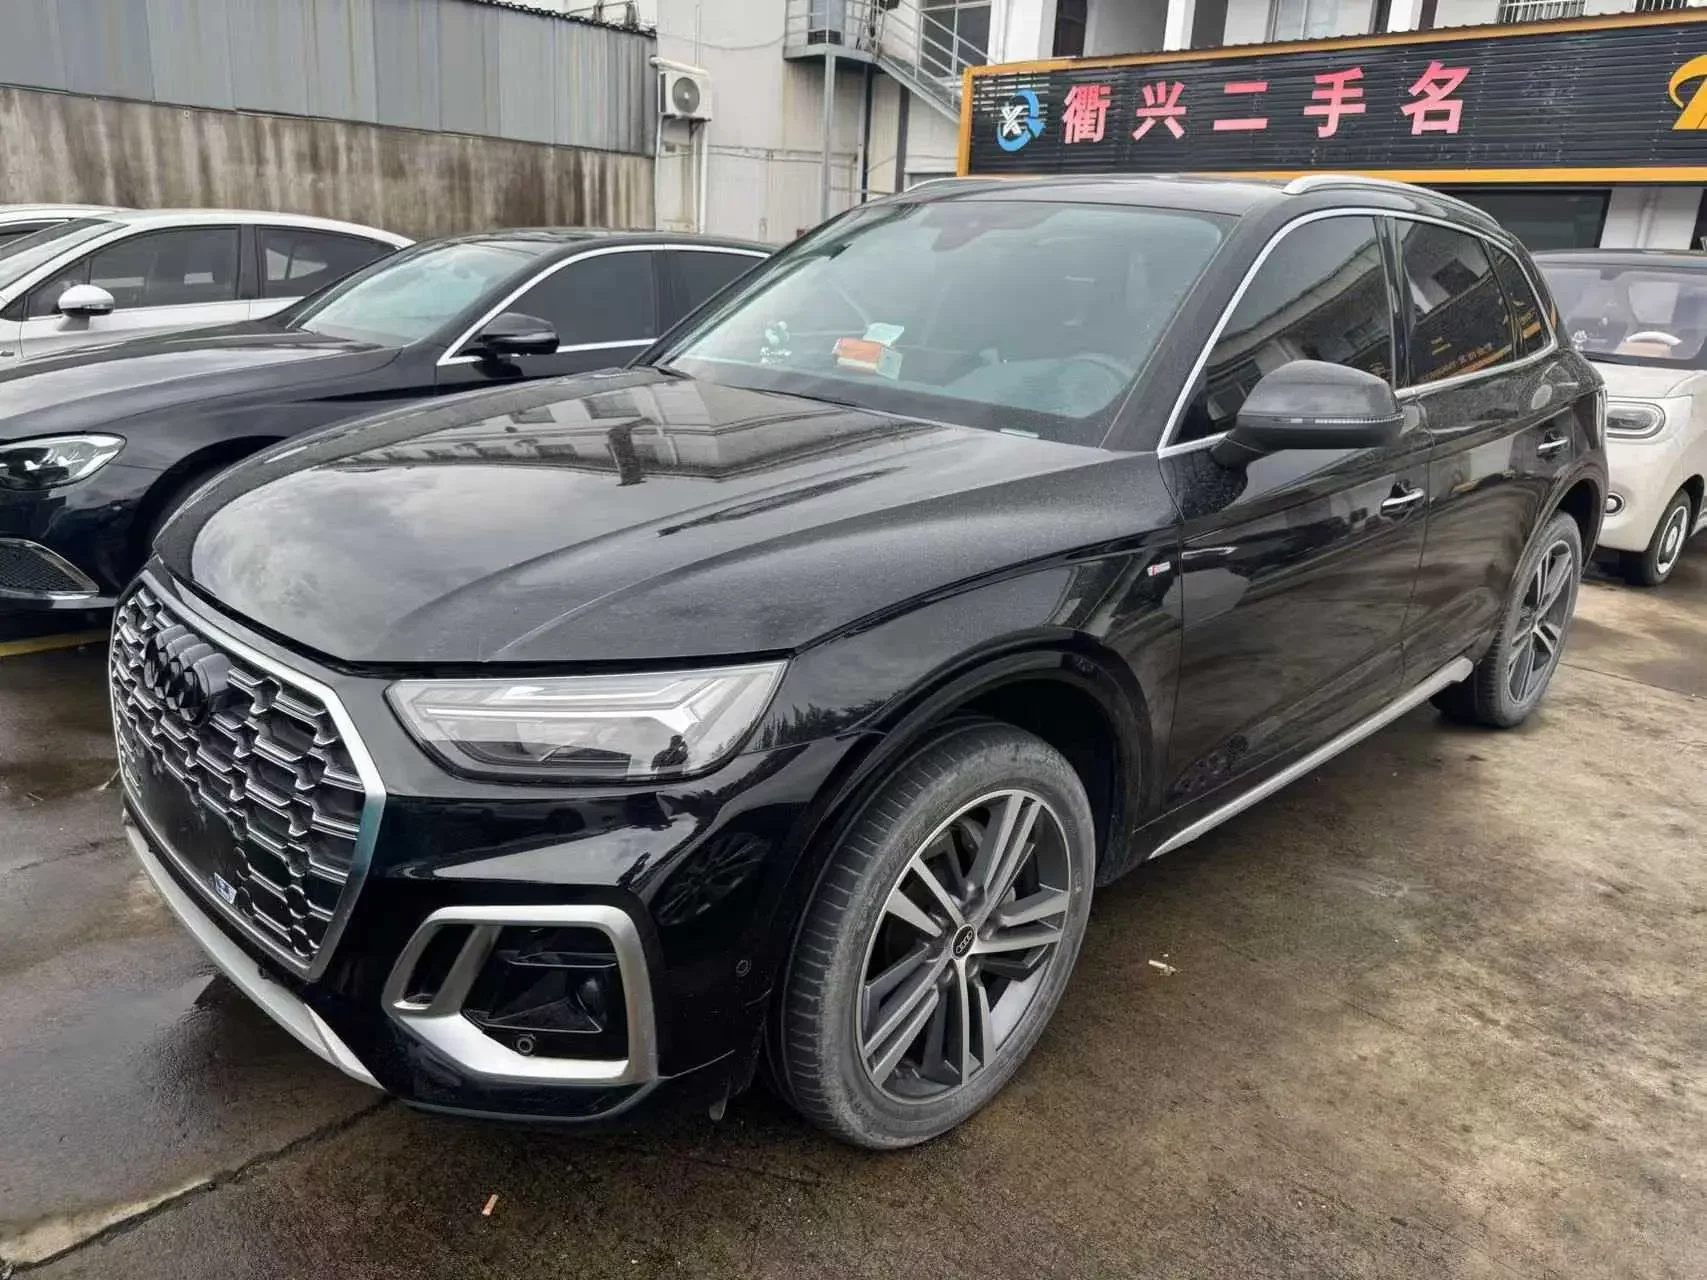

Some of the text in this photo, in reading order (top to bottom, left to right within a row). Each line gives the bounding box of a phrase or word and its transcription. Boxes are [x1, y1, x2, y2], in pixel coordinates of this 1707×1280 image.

[1062, 60, 1471, 144] 衢兴二手名
